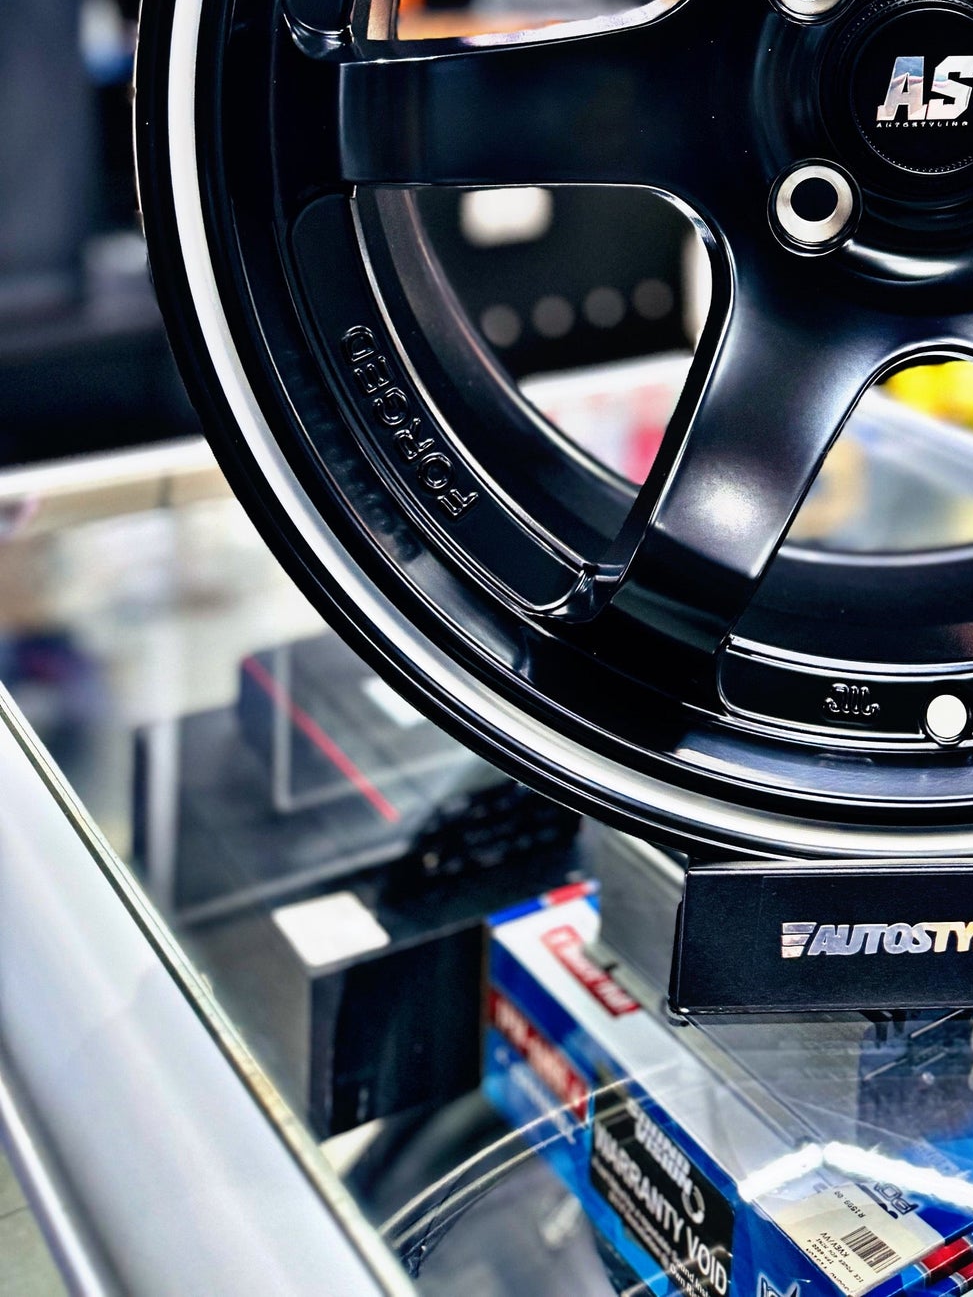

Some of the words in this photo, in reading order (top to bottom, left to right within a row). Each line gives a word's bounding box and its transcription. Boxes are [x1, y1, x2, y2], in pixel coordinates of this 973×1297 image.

[341, 325, 479, 517] FORGED
[594, 1119, 685, 1243] WARRANTY
[685, 1225, 728, 1295] VOID
